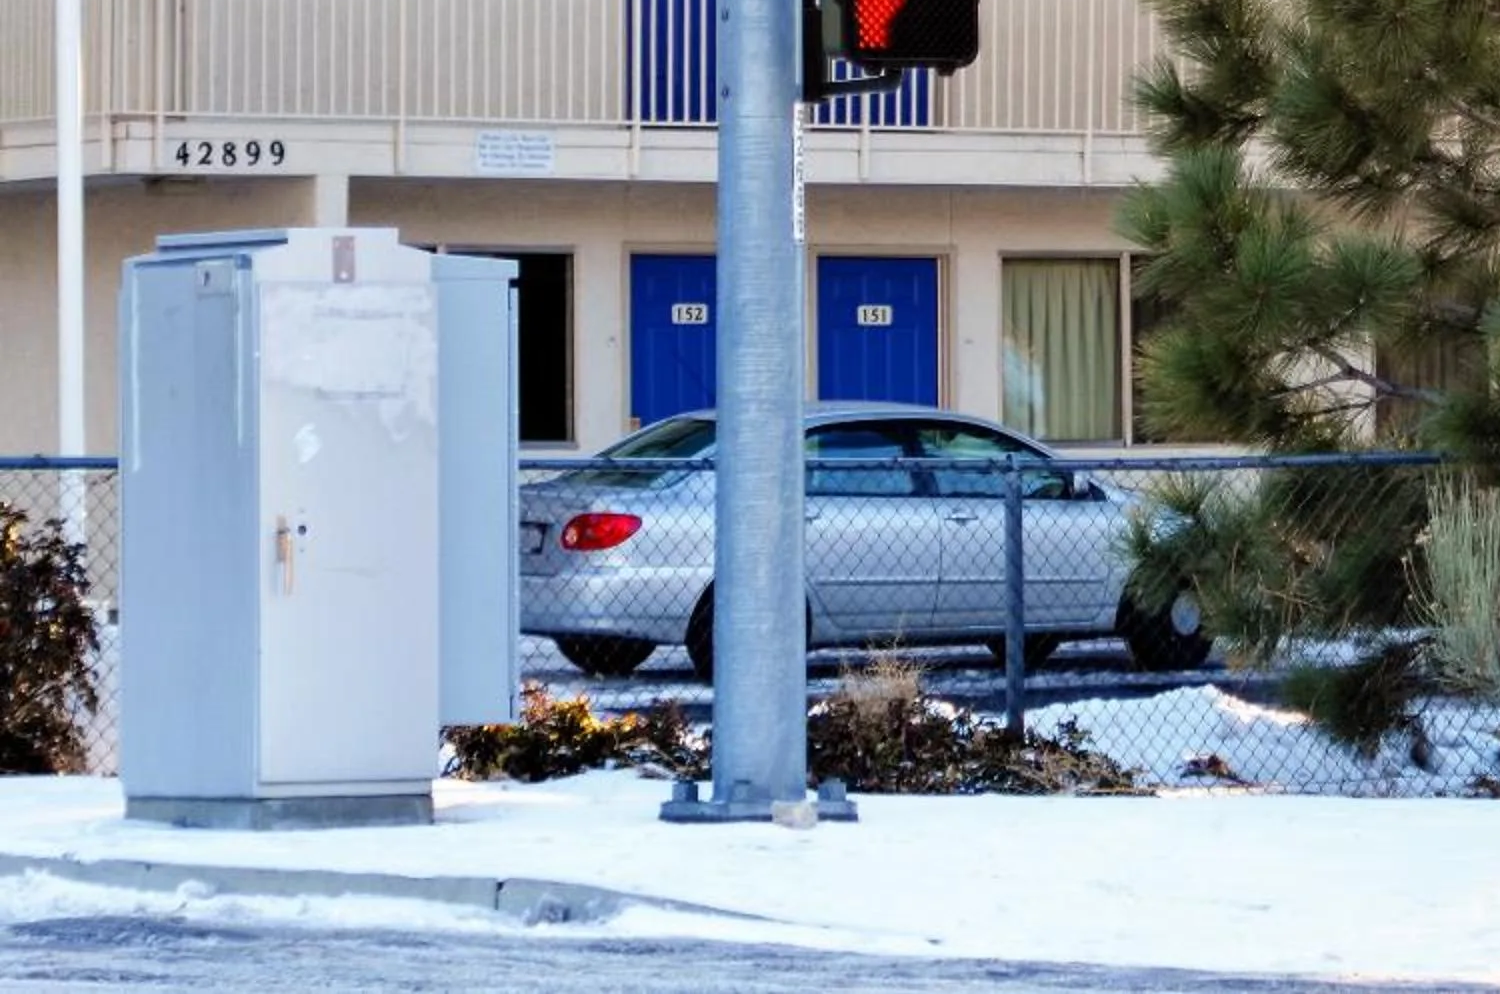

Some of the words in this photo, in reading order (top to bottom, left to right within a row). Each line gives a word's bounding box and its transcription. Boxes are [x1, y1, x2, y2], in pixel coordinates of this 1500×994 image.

[176, 140, 285, 167] 42899
[677, 307, 704, 322] 152
[862, 309, 888, 323] 151
